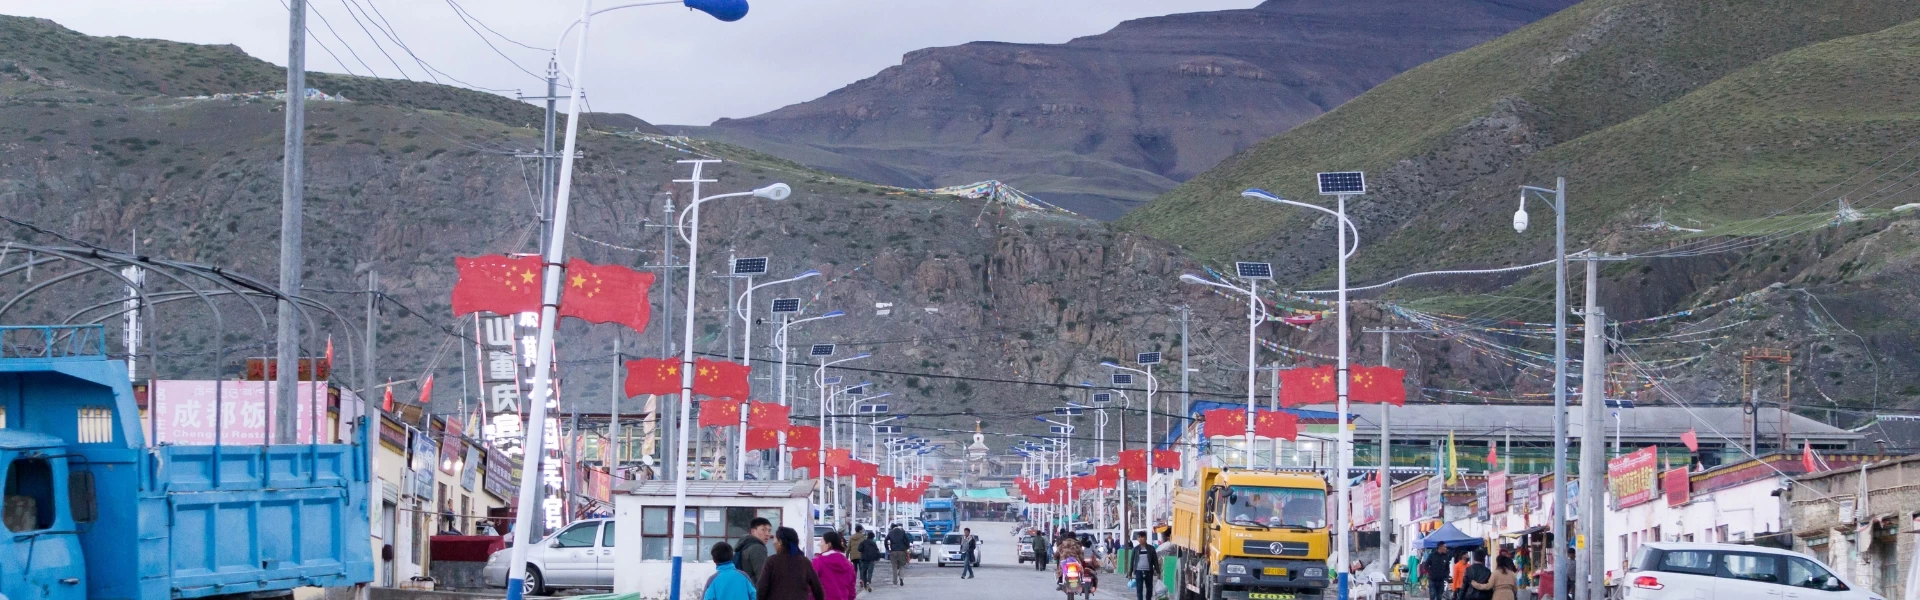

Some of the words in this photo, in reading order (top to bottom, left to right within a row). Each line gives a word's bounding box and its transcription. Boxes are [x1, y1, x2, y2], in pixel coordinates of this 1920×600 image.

[172, 400, 304, 430] 成都饭
[173, 429, 229, 439] Chengu
[232, 430, 302, 439] Restaut
